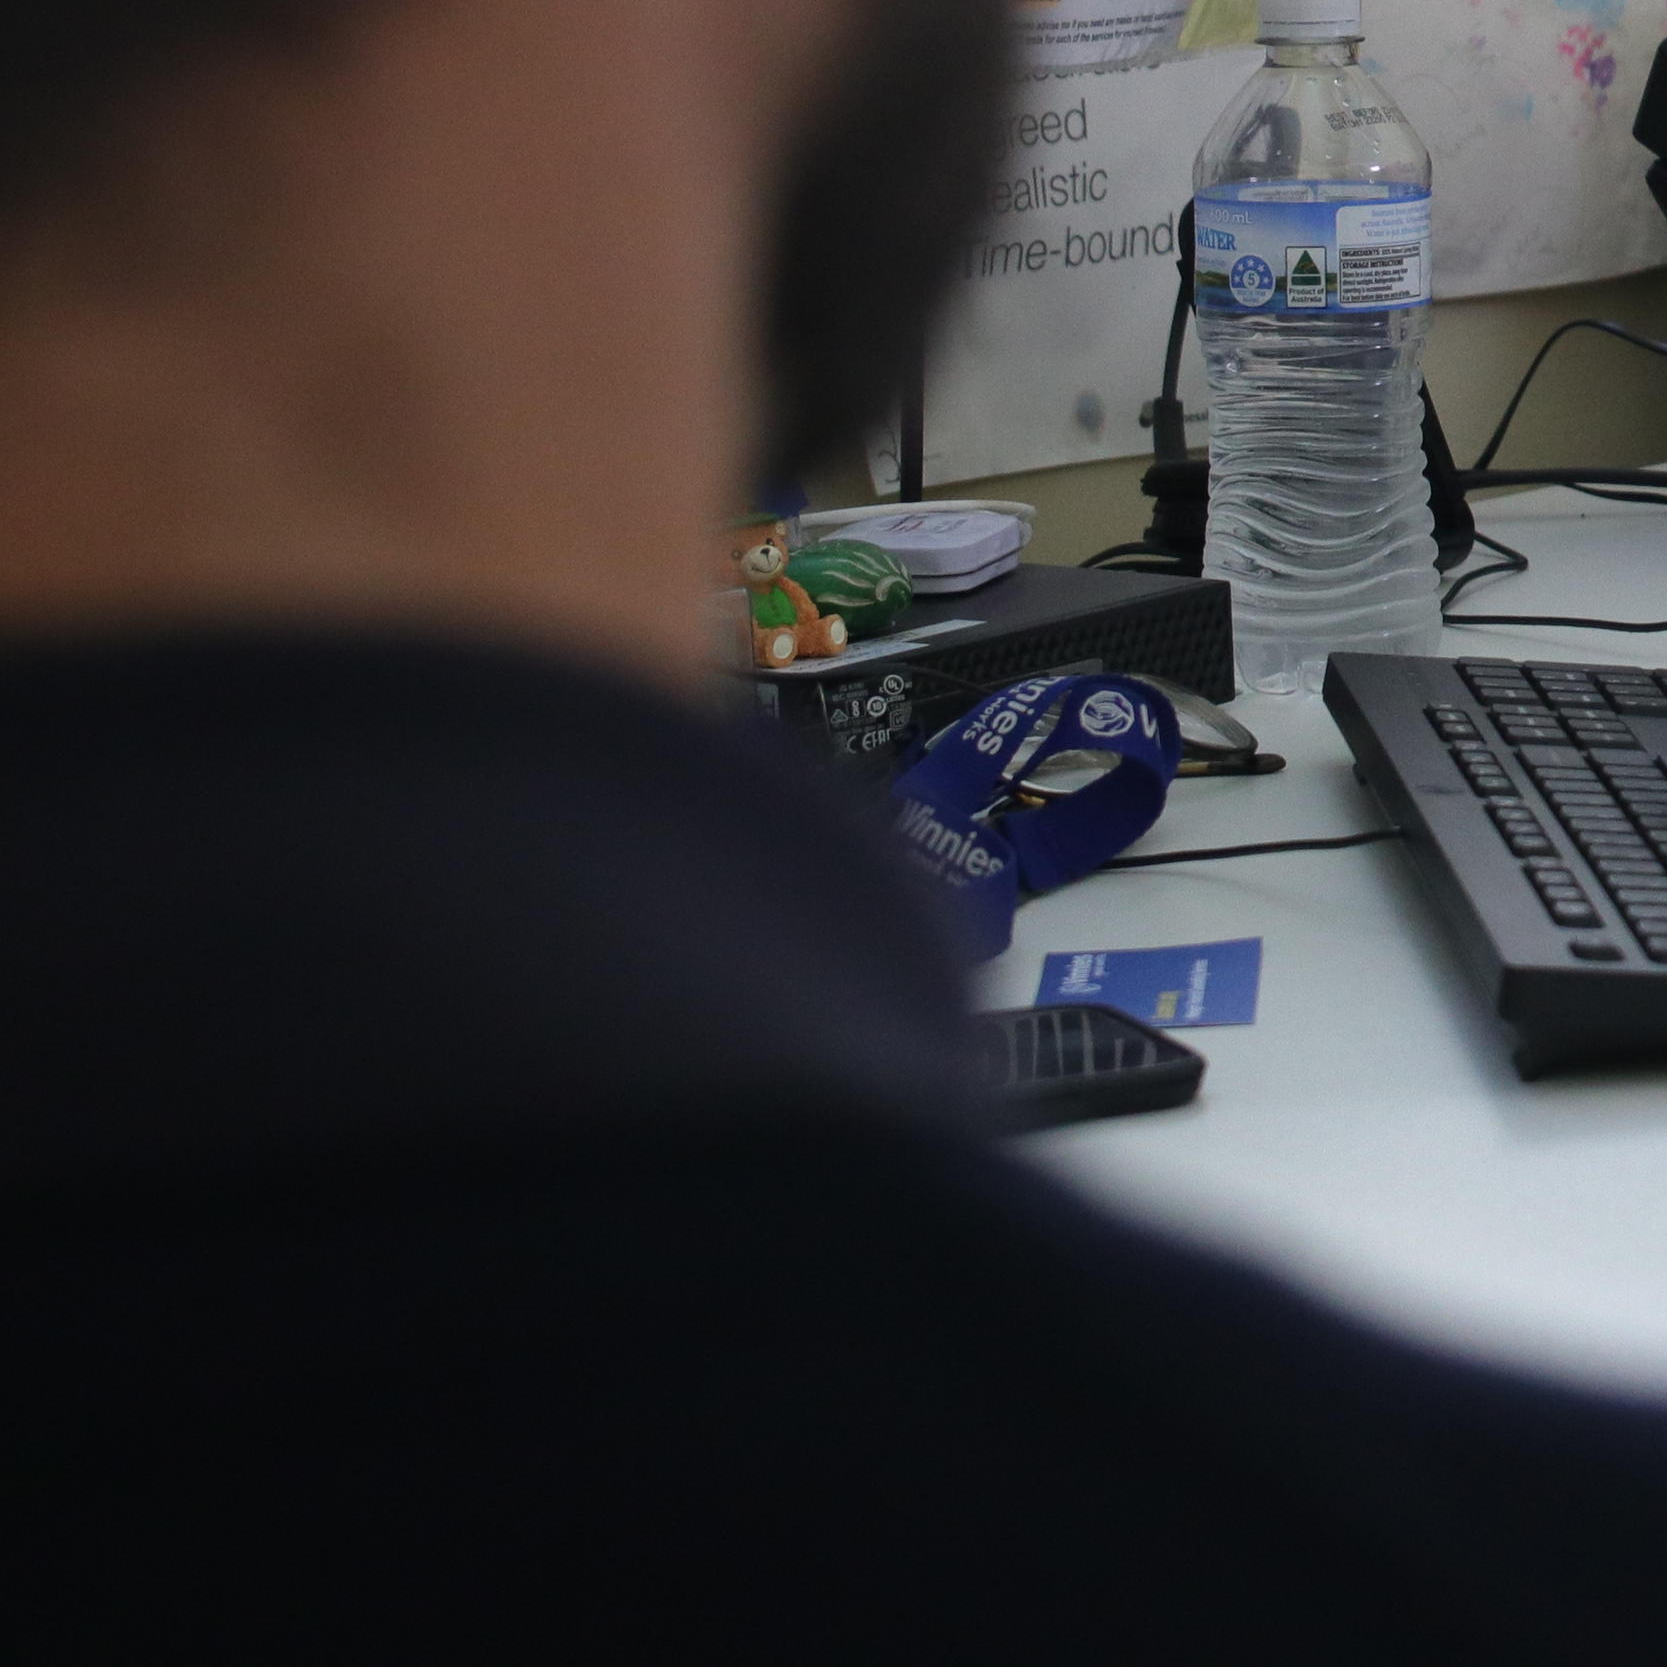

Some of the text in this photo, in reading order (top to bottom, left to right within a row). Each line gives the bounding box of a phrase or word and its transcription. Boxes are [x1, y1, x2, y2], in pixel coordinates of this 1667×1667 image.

[992, 161, 1109, 214] ealistic
[979, 212, 1175, 278] ime-bound
[1247, 273, 1257, 287] 5
[1289, 287, 1316, 296] Product
[1290, 295, 1323, 304] Australia
[902, 798, 1004, 878] Vinnies
